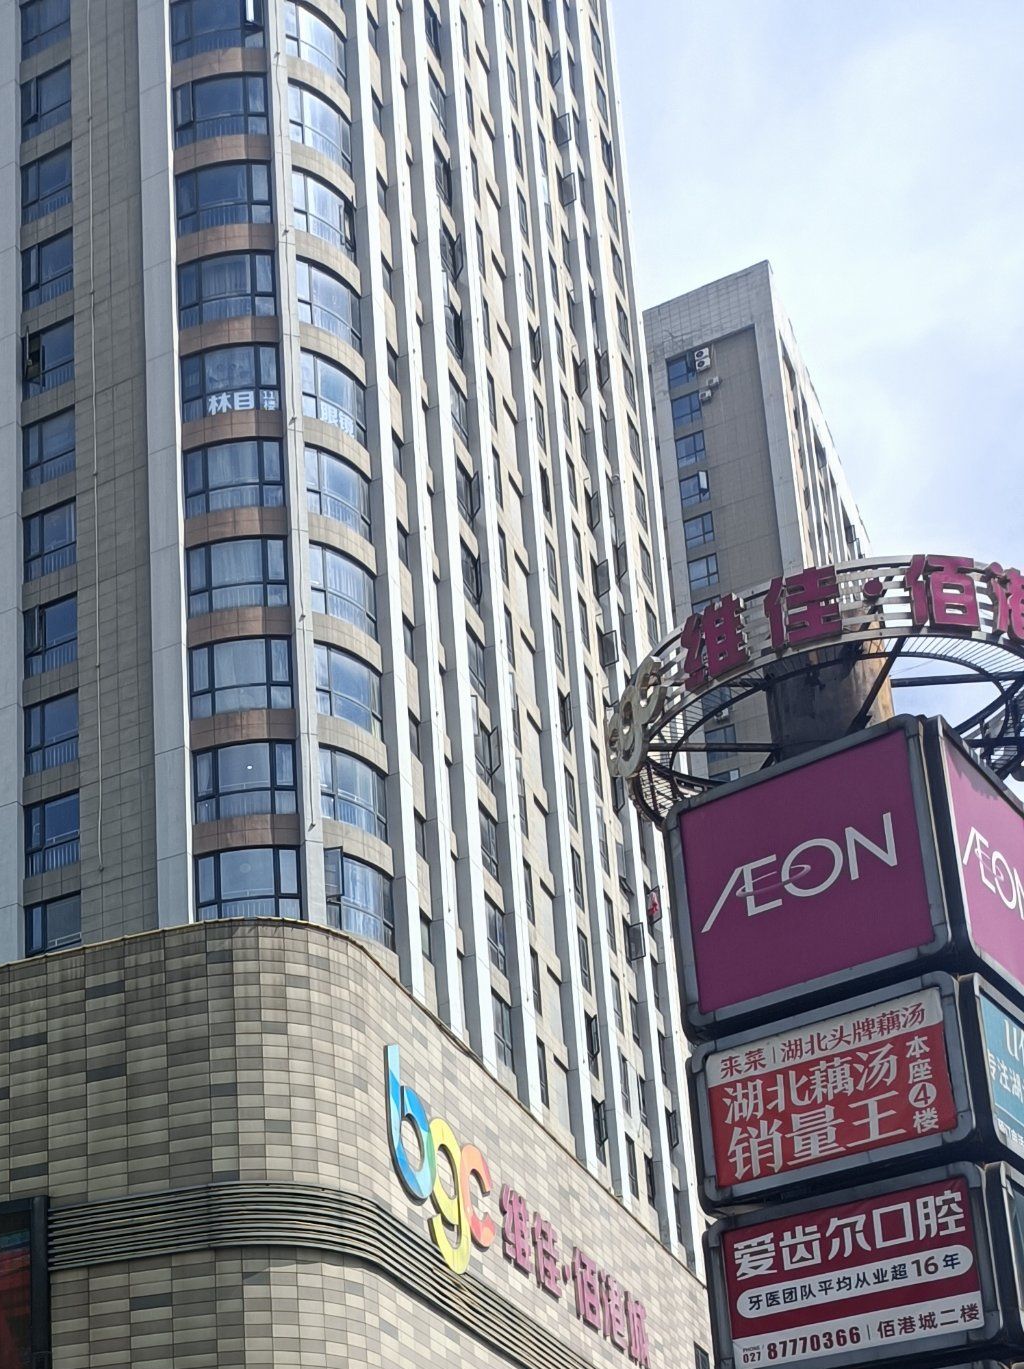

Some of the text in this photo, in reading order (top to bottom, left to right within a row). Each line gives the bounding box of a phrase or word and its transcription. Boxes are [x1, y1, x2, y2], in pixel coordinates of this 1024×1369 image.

[780, 1002, 926, 1063] 湖北头牌藕汤
[722, 1043, 898, 1125] 湖北藕汤
[727, 1090, 908, 1181] 销量王
[733, 1190, 966, 1281] 爱齿尔口腔
[742, 1304, 980, 1364] 027 87770366 佰港城二楼
